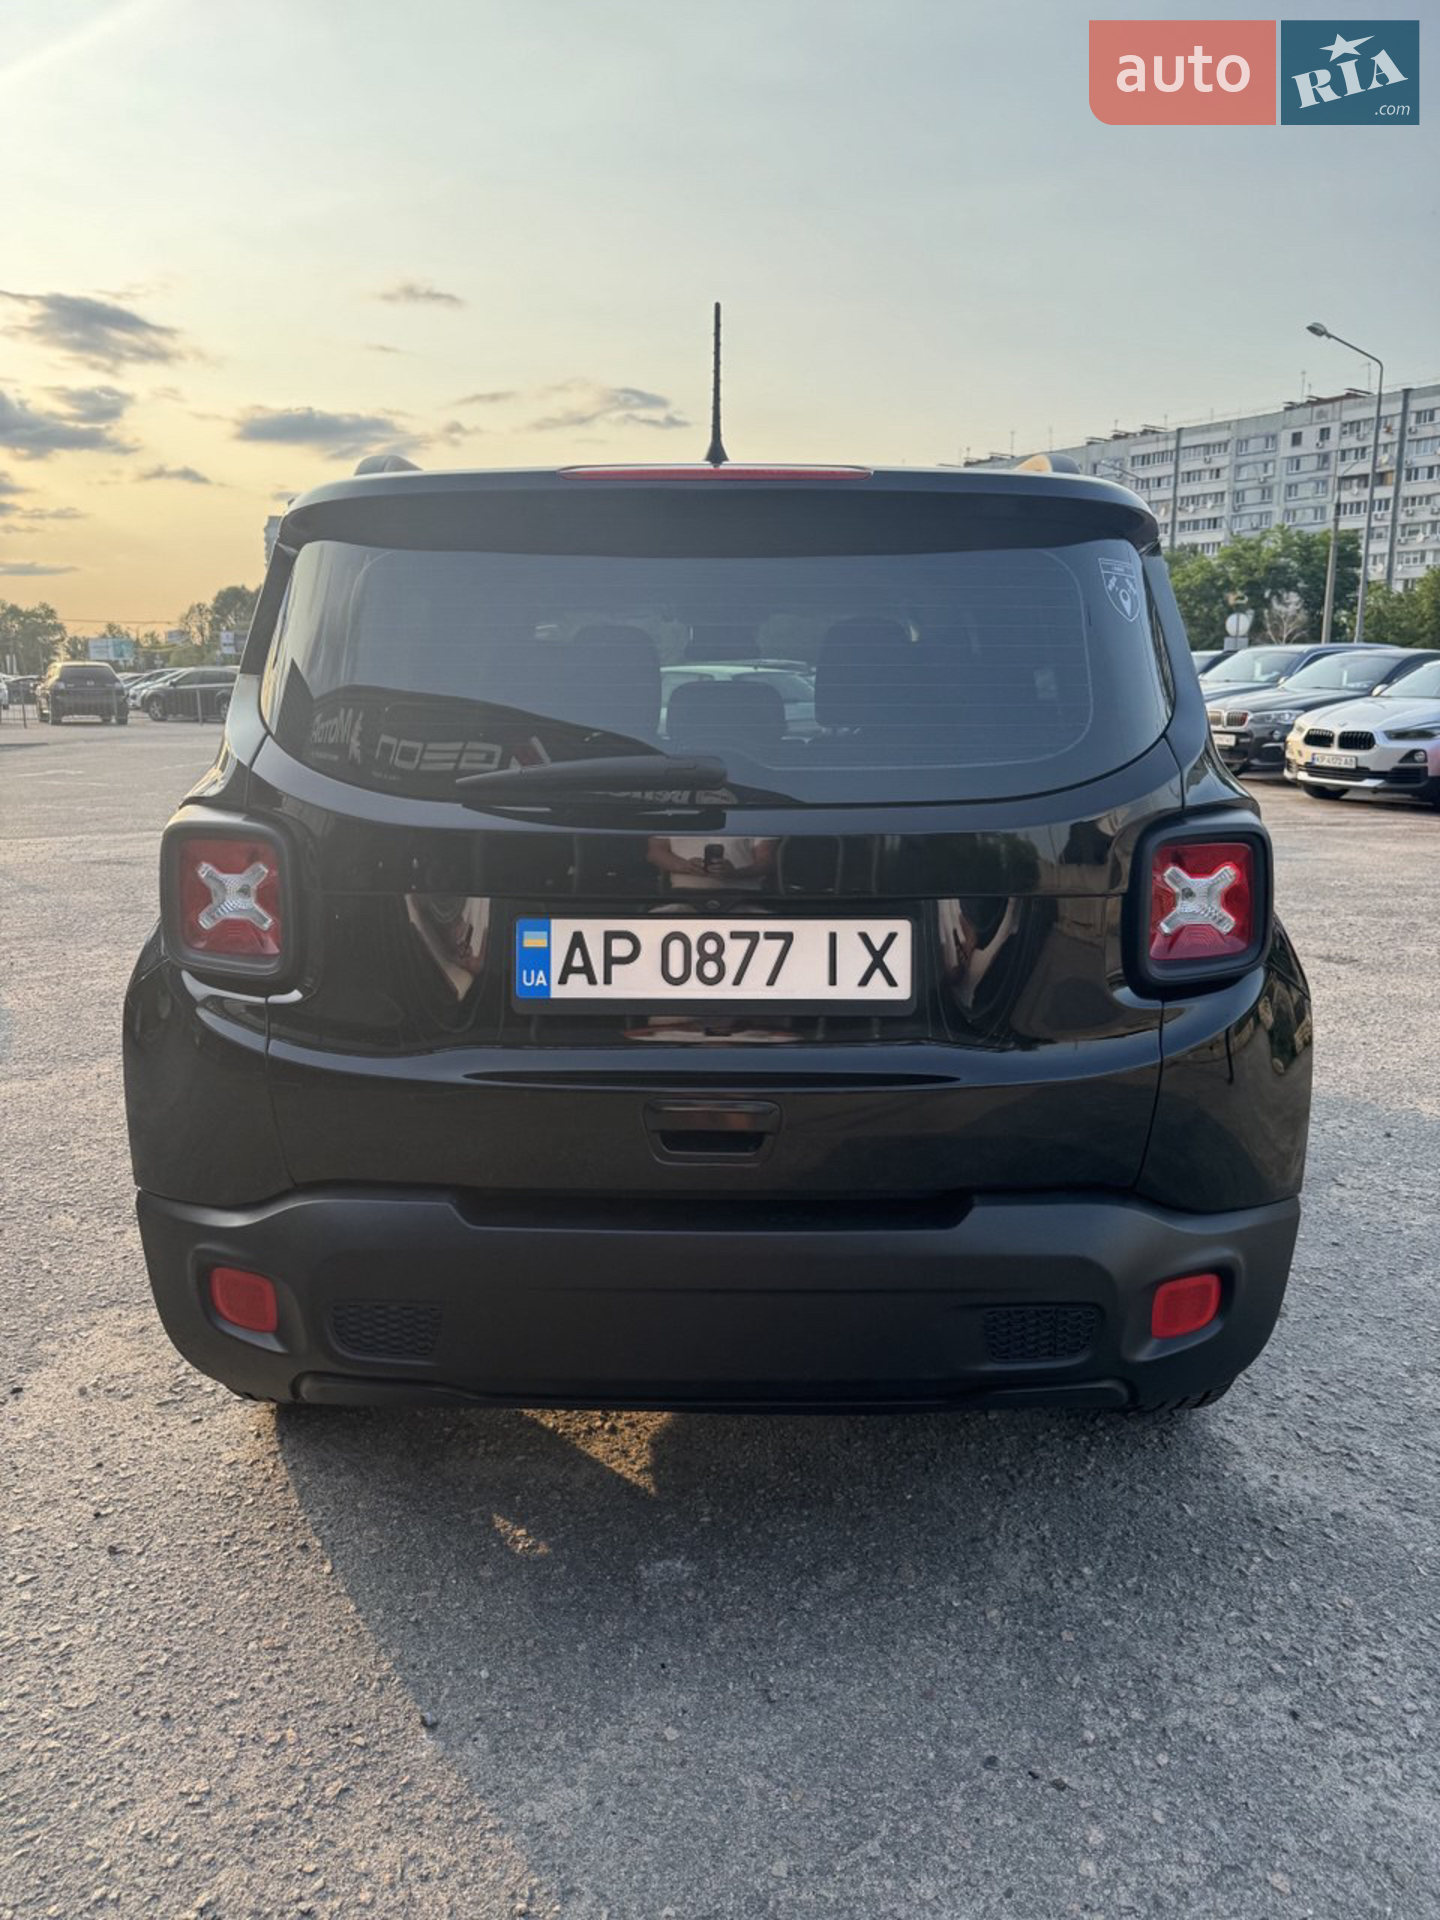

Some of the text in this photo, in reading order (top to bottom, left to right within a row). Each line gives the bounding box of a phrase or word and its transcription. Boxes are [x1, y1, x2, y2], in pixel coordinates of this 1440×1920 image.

[557, 930, 899, 987] AP 0877 IX
[522, 969, 547, 986] UA
